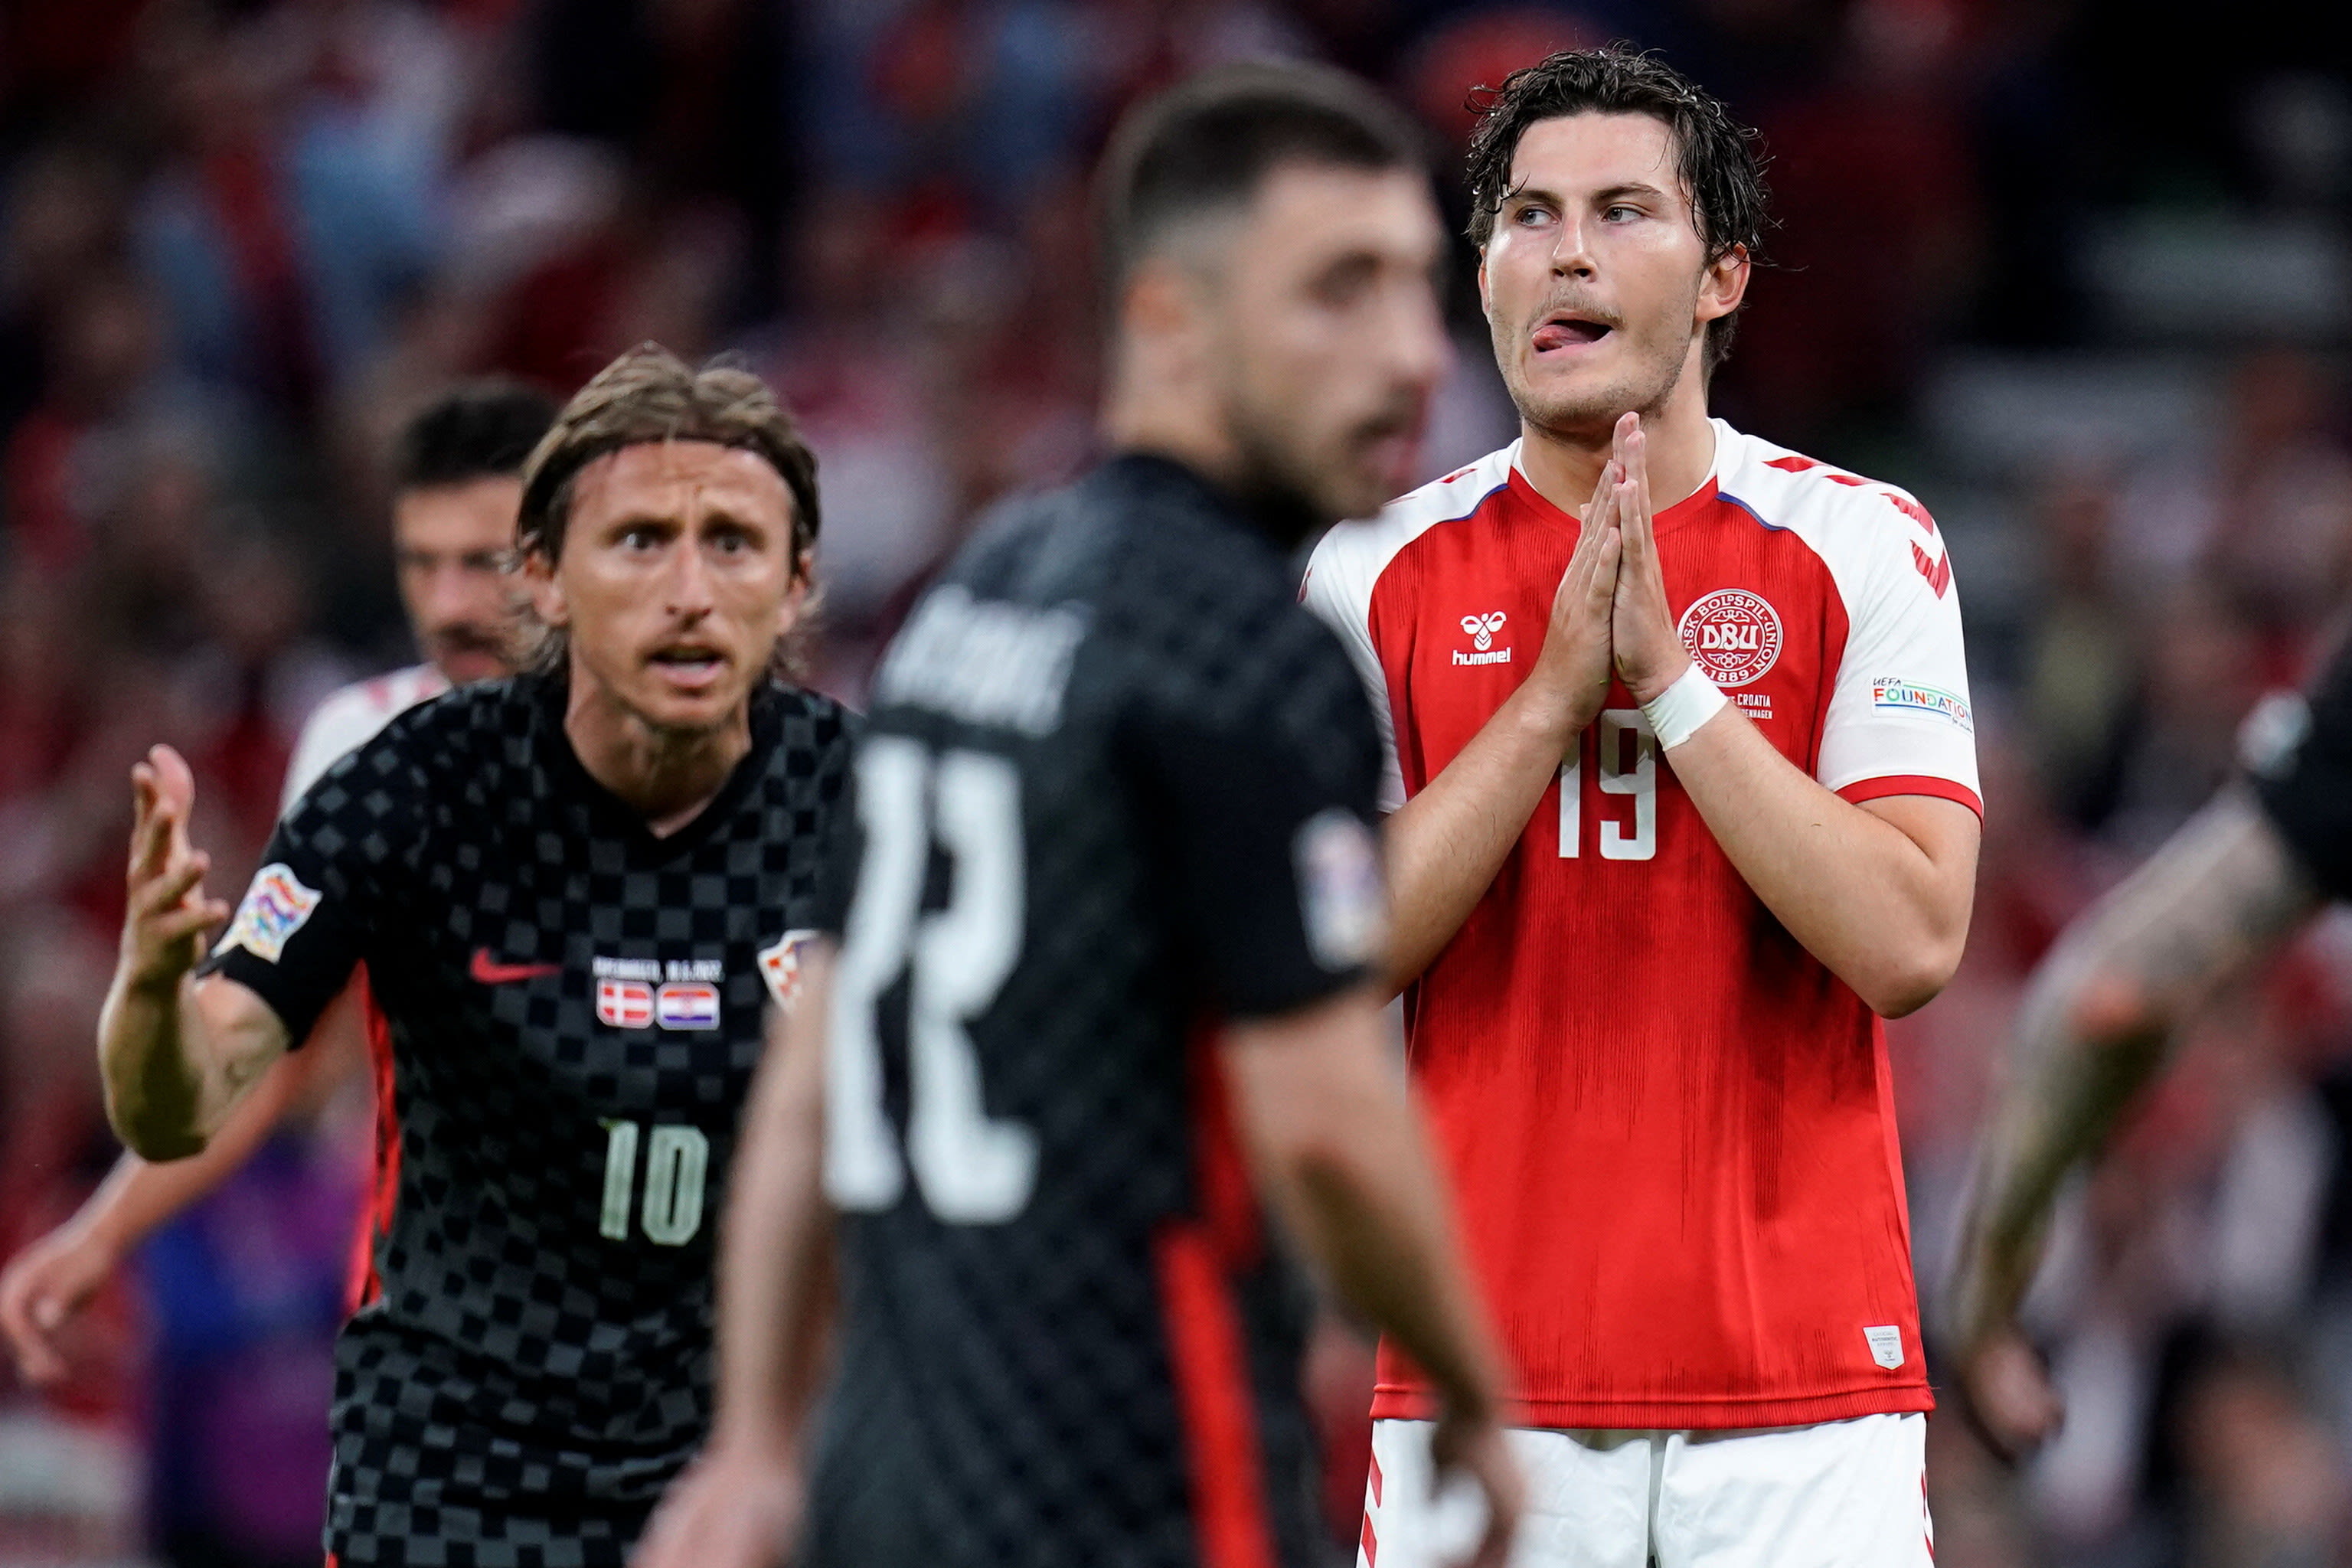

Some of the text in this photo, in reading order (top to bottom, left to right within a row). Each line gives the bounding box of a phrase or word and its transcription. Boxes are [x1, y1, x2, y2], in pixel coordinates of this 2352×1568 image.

[1700, 622, 1759, 651] DBU
[1452, 647, 1511, 665] hummel
[1709, 668, 1749, 682] 1889
[1873, 678, 1902, 687] UEFA
[1737, 694, 1771, 707] CROATIA
[1873, 688, 1972, 724] FOUNDATION
[1558, 709, 1656, 861] 19
[597, 1116, 710, 1247] 10
